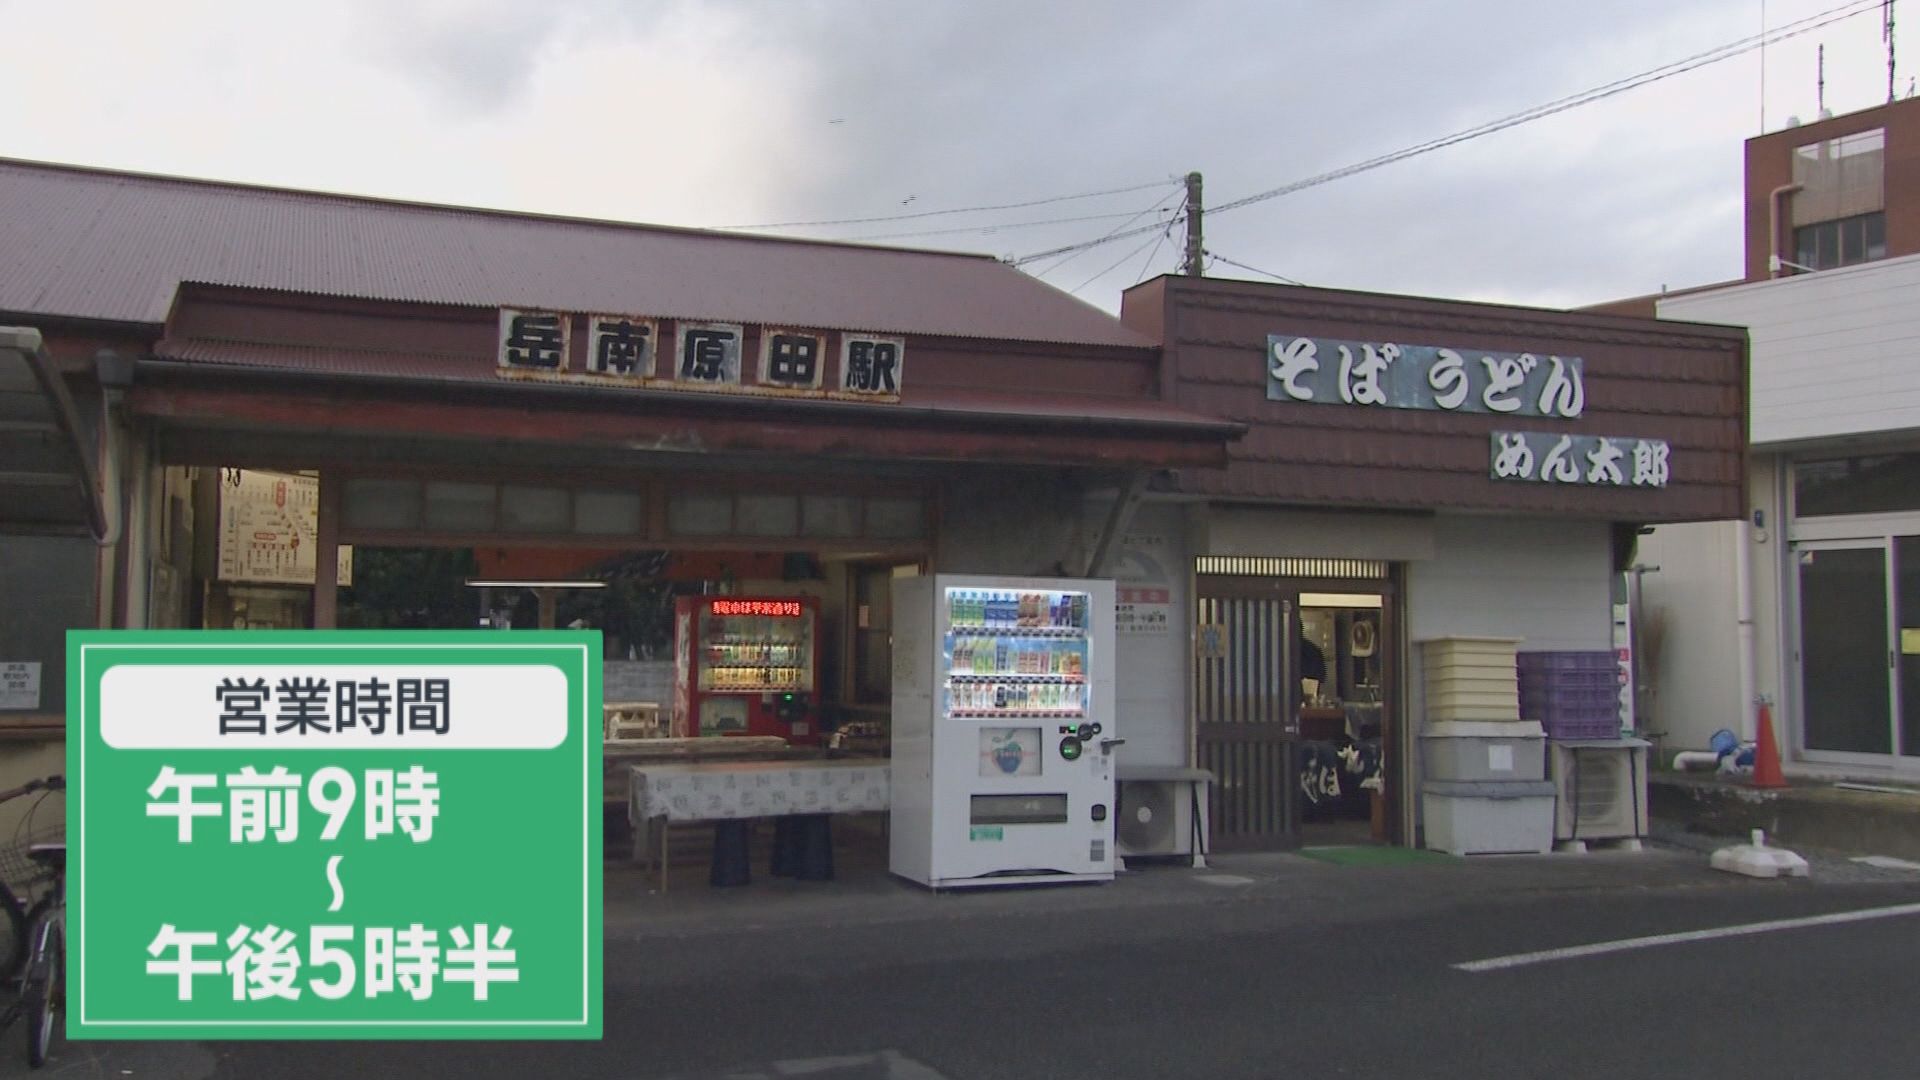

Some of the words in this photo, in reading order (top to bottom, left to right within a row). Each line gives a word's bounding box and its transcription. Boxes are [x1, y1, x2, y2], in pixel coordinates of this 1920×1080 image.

[506, 315, 899, 392] 岳南原田駅
[1272, 336, 1402, 405] そば
[1428, 348, 1585, 418] うどん
[1493, 433, 1670, 487] めん太郎
